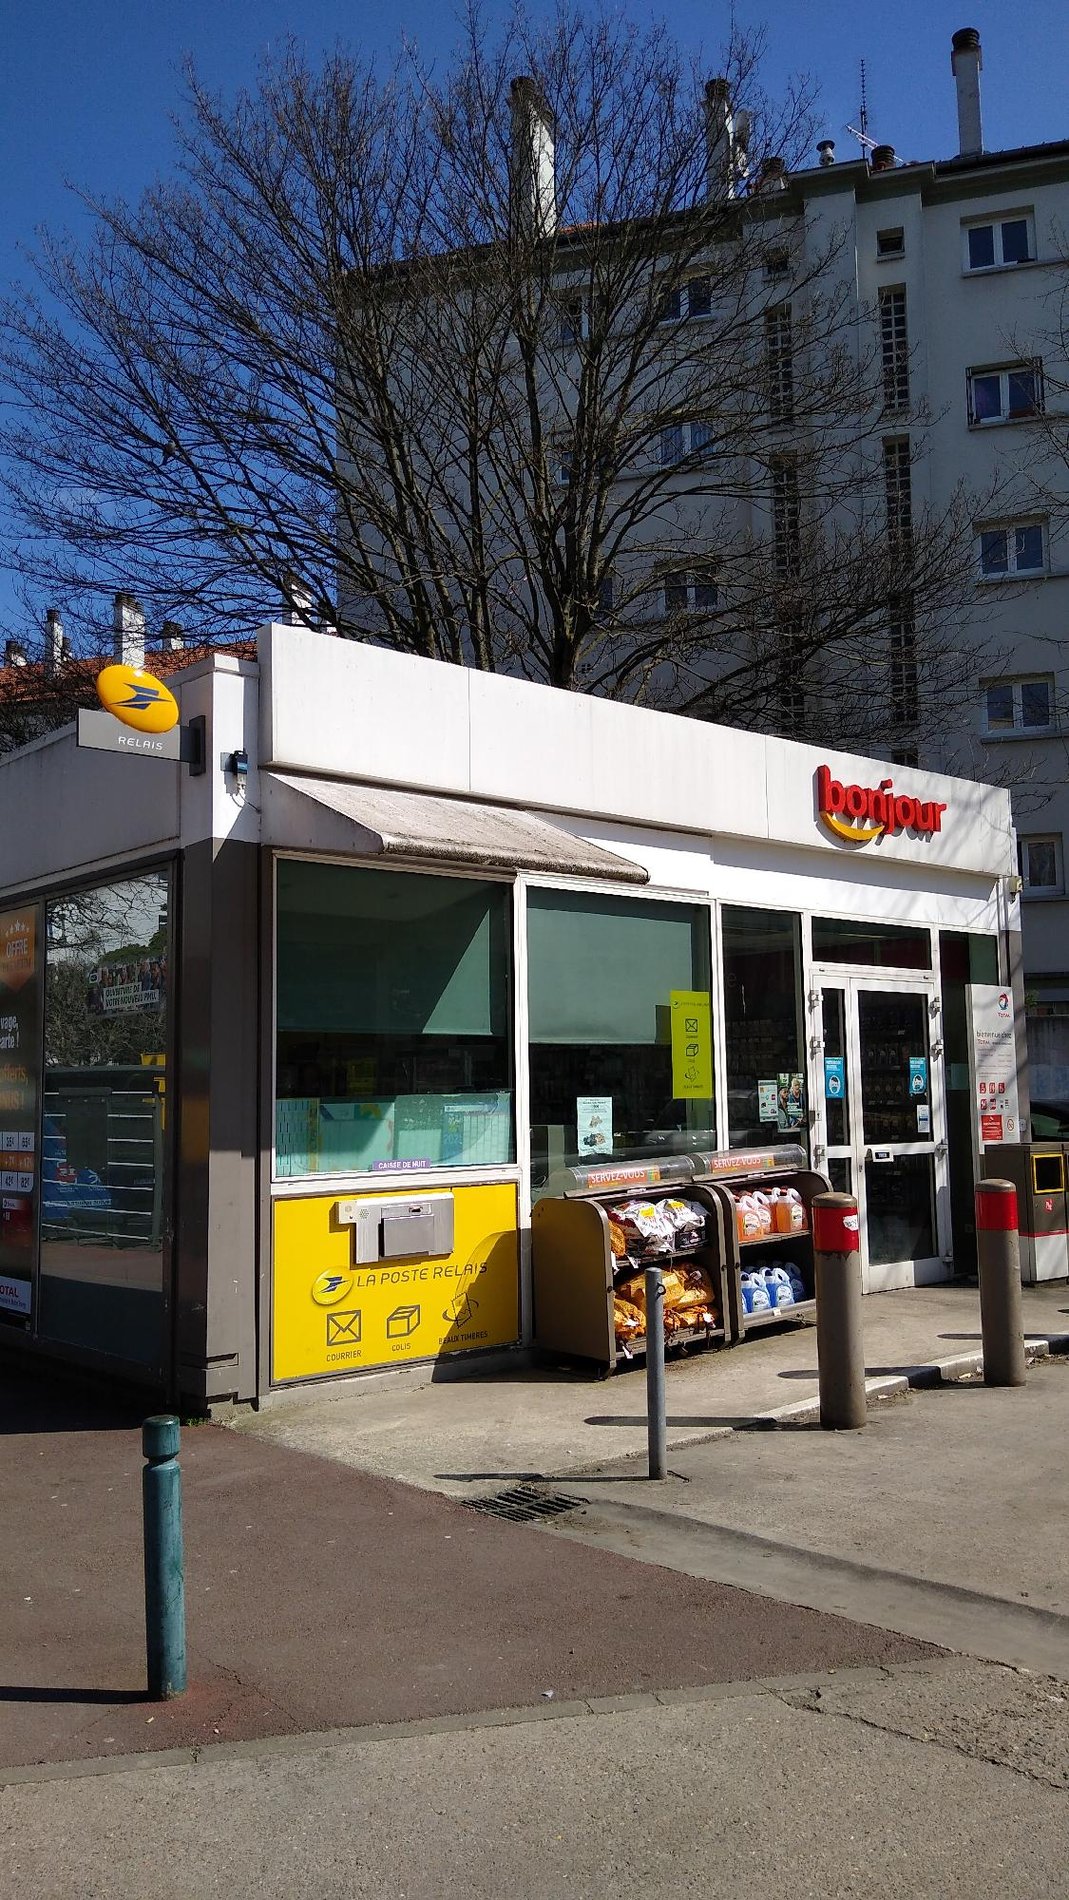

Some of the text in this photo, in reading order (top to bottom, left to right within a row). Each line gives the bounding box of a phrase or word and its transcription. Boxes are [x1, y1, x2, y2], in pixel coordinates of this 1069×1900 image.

[118, 736, 163, 750] RELAIS
[817, 765, 947, 834] bonjour
[6, 938, 28, 958] OFFRE
[133, 984, 141, 993] DE
[378, 1160, 426, 1169] CAISSE DE NUIT
[590, 1169, 646, 1184] SERVEZ-VOUS
[357, 1262, 488, 1287] LA POSTE RELAIS
[438, 1330, 489, 1345] BEAUX TIMBRES
[391, 1342, 411, 1352] COLIS
[326, 1350, 362, 1362] COURRIER
